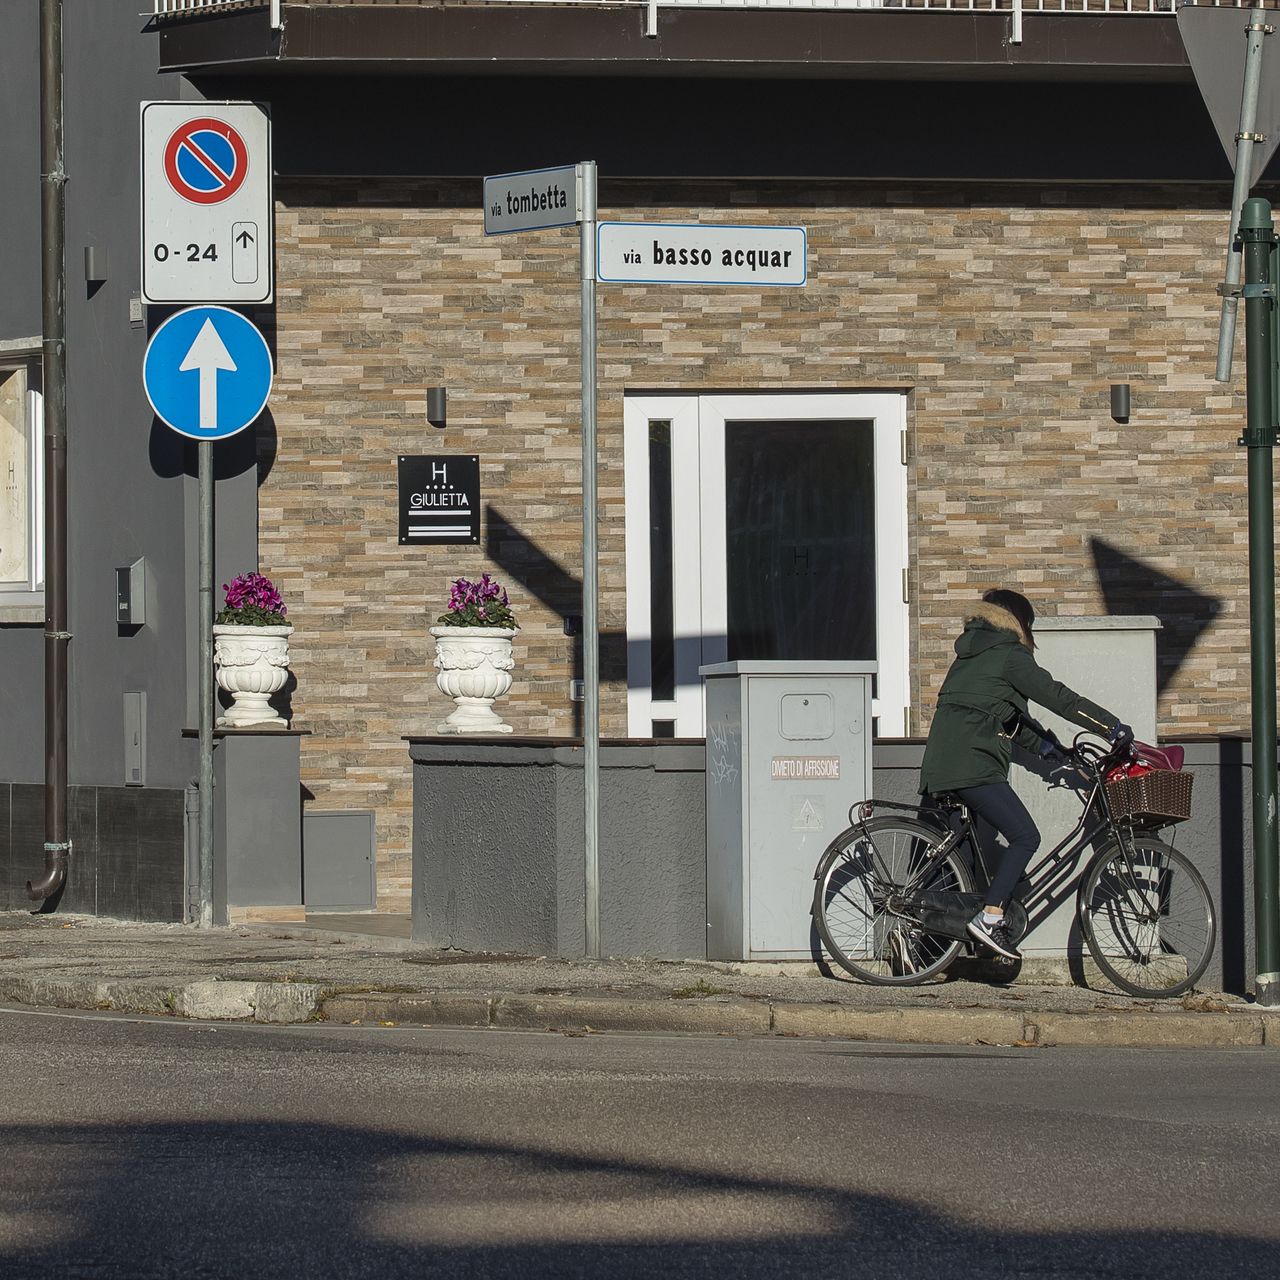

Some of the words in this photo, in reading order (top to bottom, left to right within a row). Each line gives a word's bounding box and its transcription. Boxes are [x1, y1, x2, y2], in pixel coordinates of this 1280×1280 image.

[491, 202, 502, 217] via
[506, 184, 567, 215] tombetta
[623, 249, 642, 264] via
[653, 240, 712, 266] basso
[721, 249, 792, 271] acquar
[432, 462, 447, 484] H
[410, 493, 469, 507] GIULIETTA
